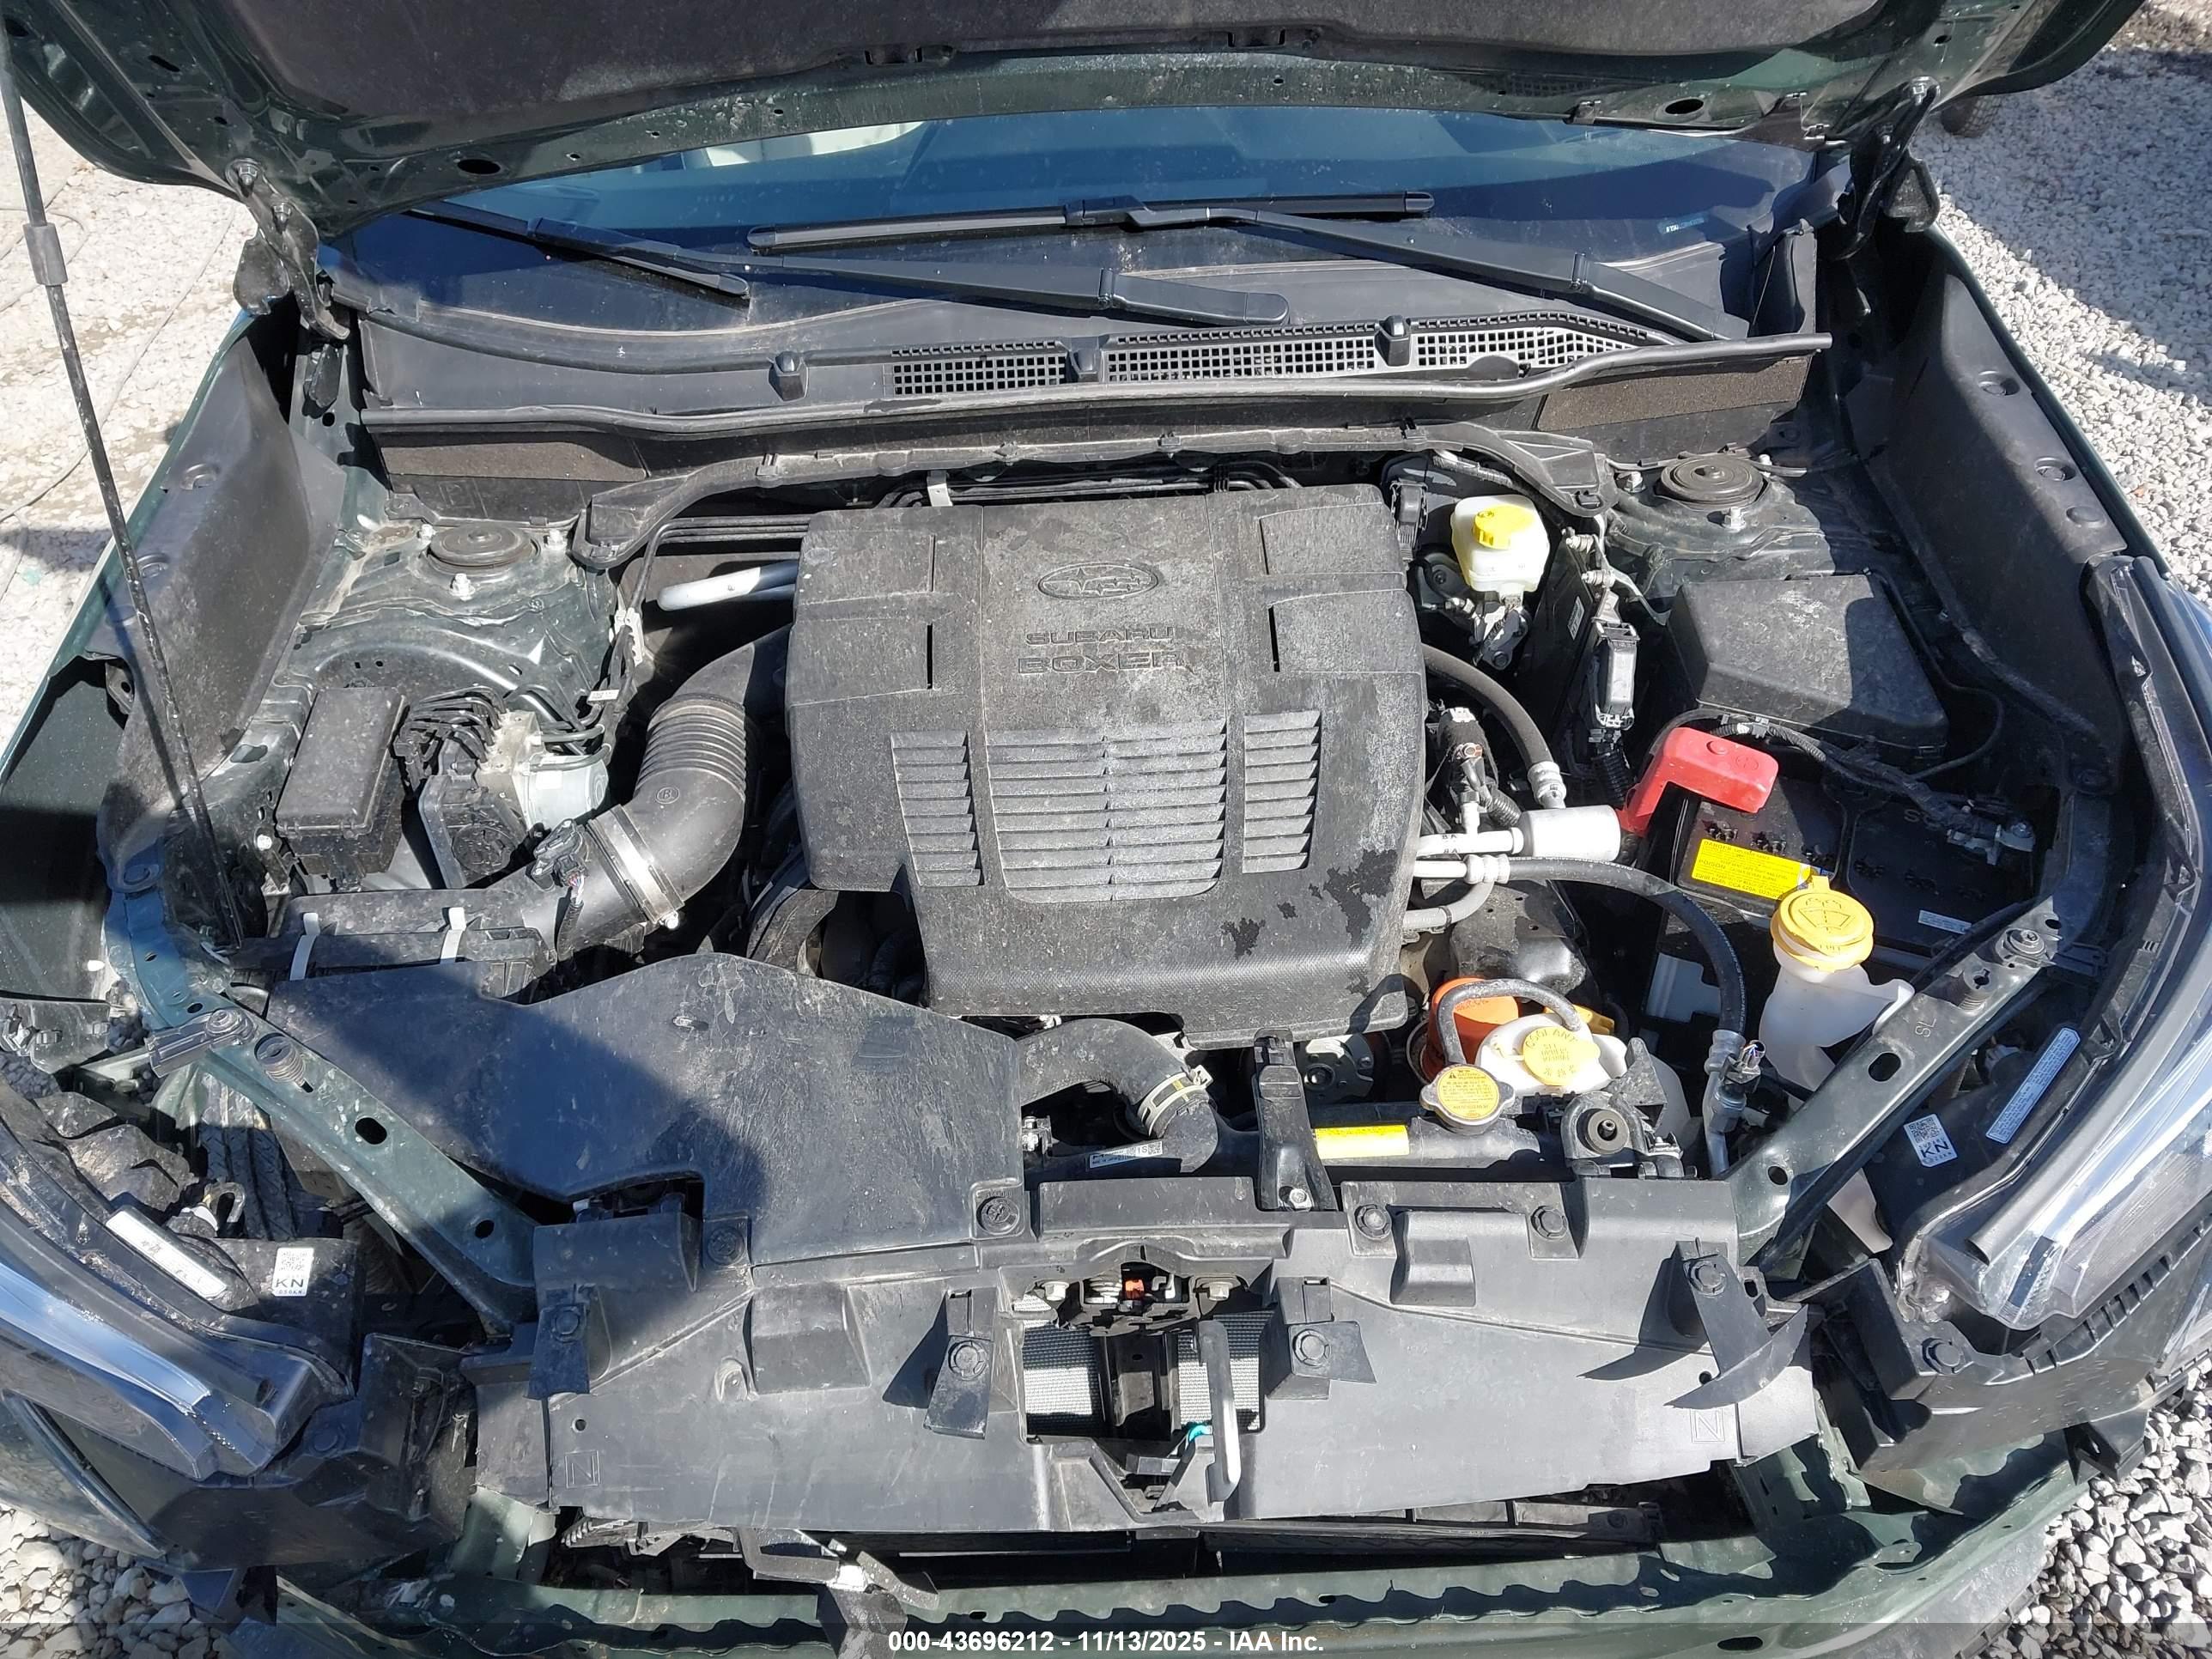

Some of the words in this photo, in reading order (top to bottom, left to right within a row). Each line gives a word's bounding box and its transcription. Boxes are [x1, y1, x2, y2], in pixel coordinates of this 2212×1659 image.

[1025, 627, 1175, 645] SUBARU
[1018, 650, 1195, 674] BOXER
[1920, 1141, 1949, 1158] KN
[275, 1279, 304, 1288] KN
